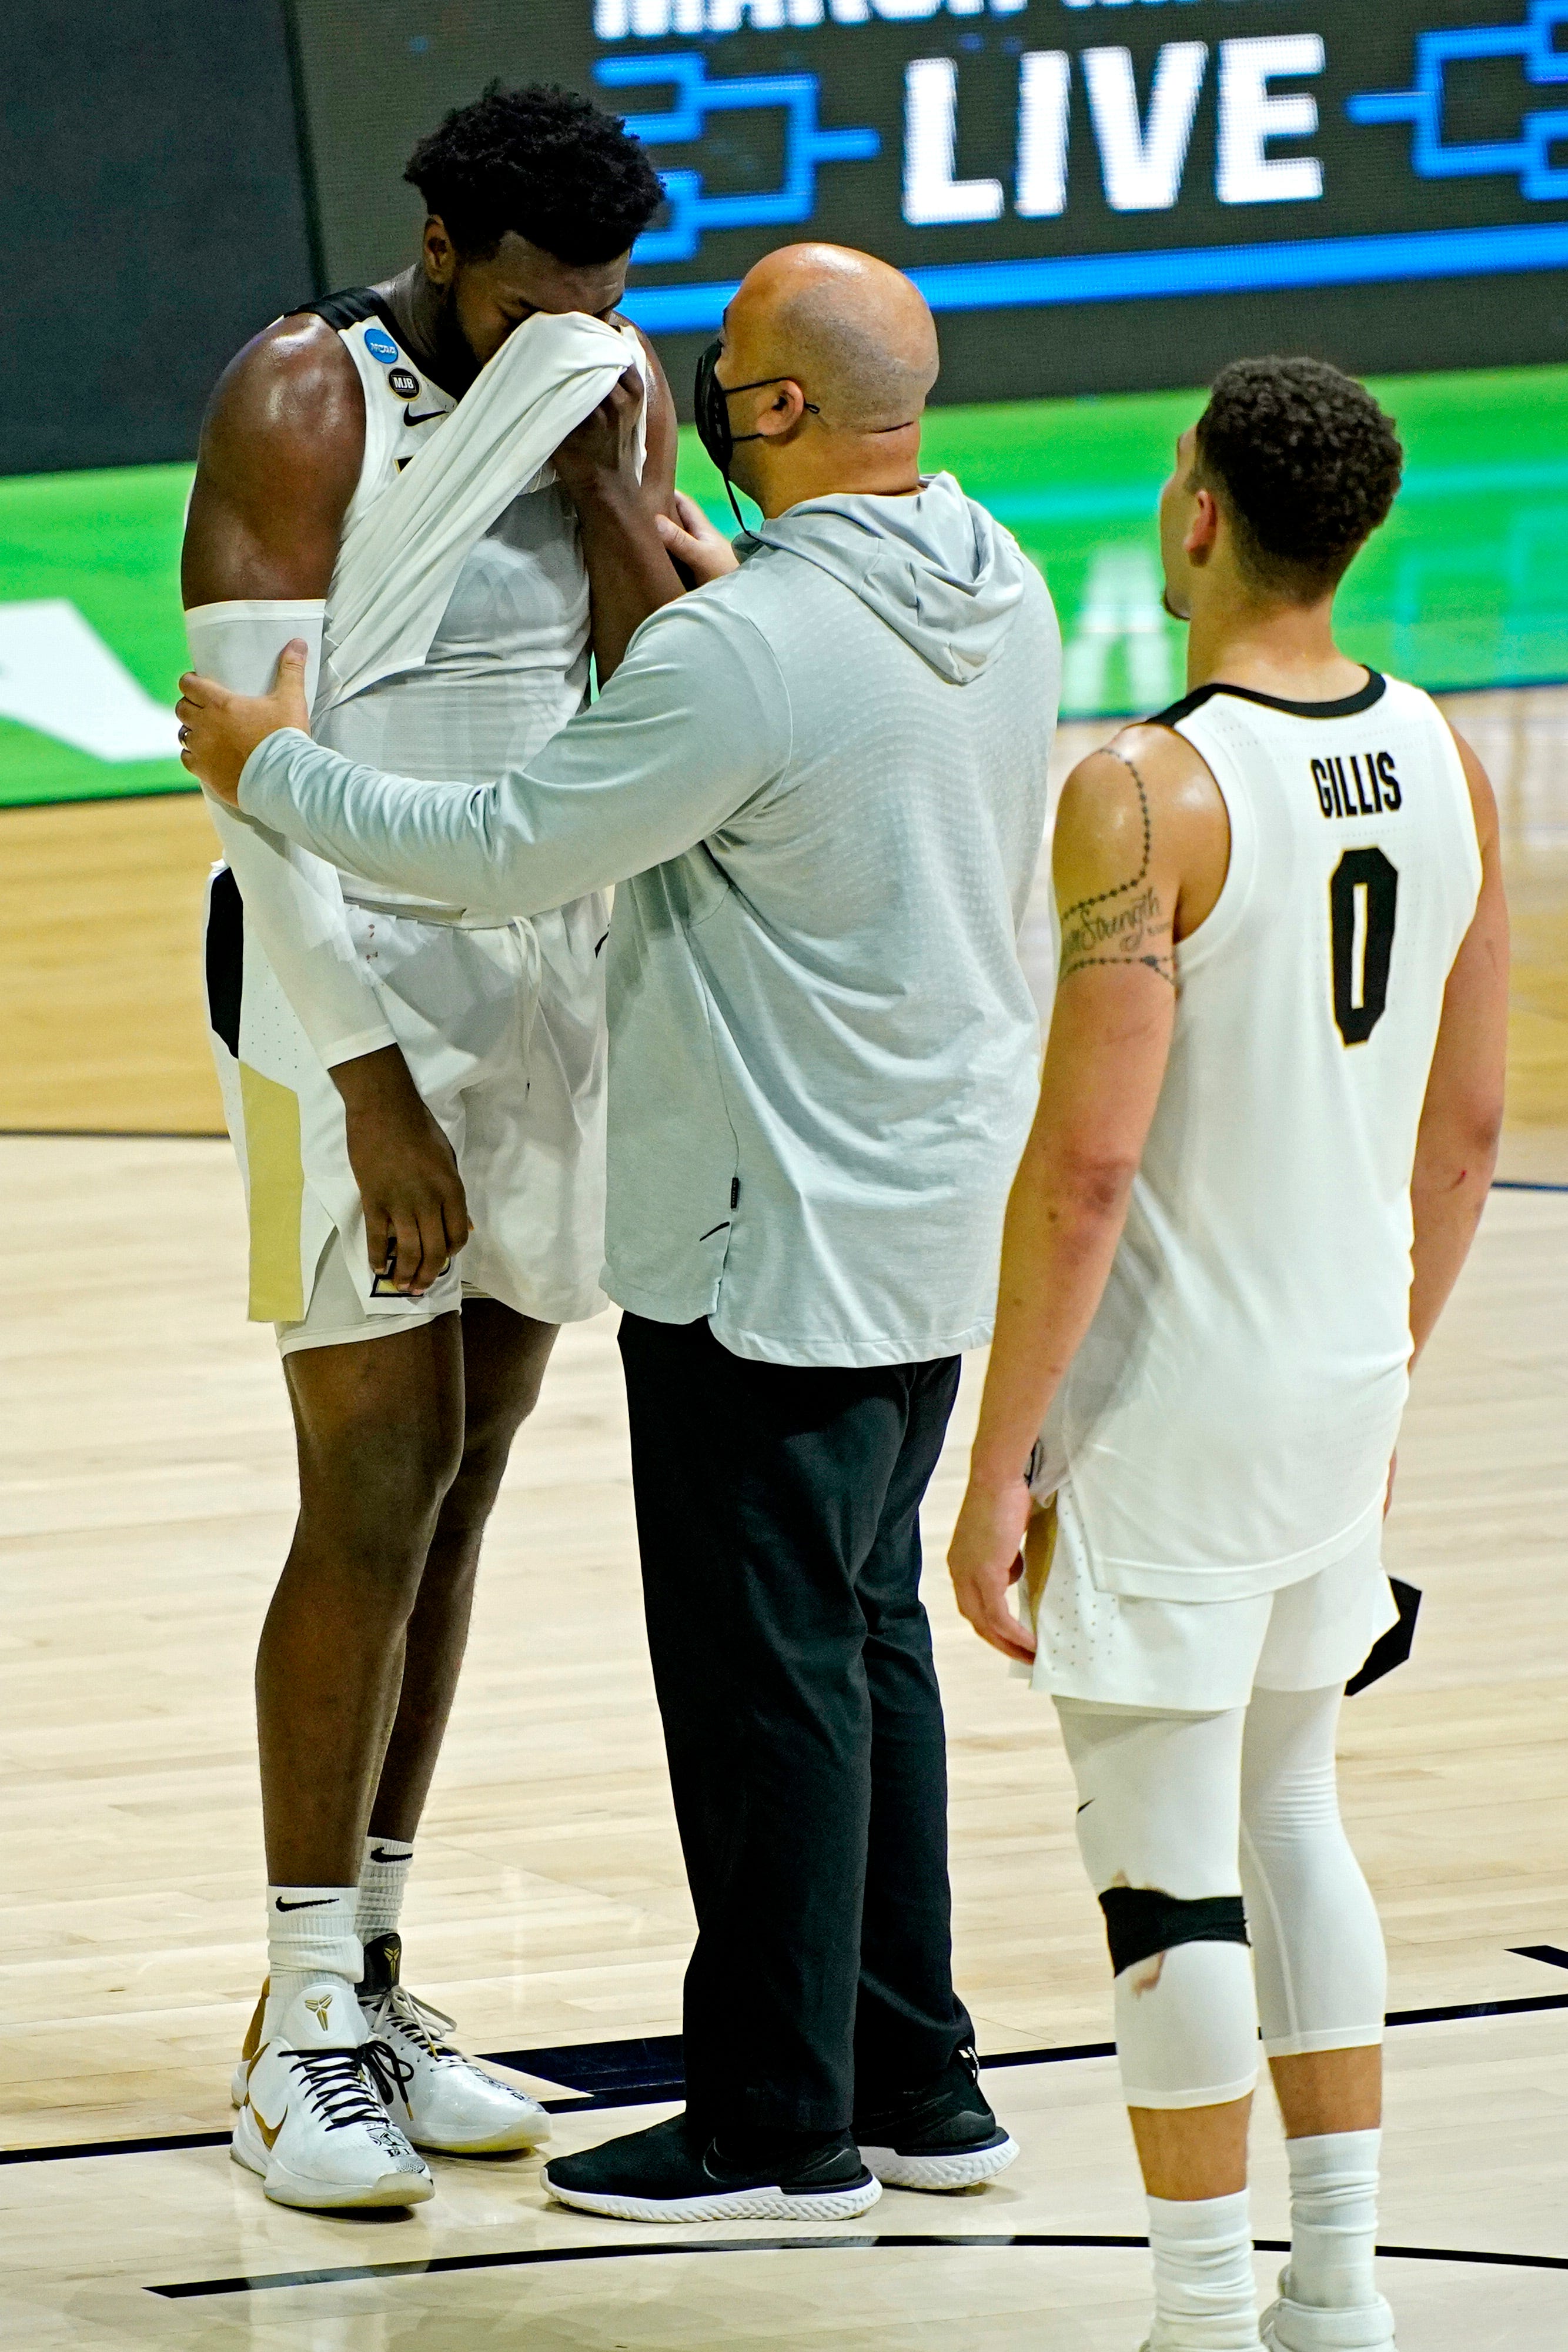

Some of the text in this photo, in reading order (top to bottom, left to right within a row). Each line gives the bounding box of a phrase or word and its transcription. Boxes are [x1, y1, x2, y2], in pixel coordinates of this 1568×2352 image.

[902, 32, 1326, 226] LIVE
[393, 377, 414, 389] MJB
[1309, 750, 1402, 819] GILLIS
[1329, 846, 1399, 1047] 0
